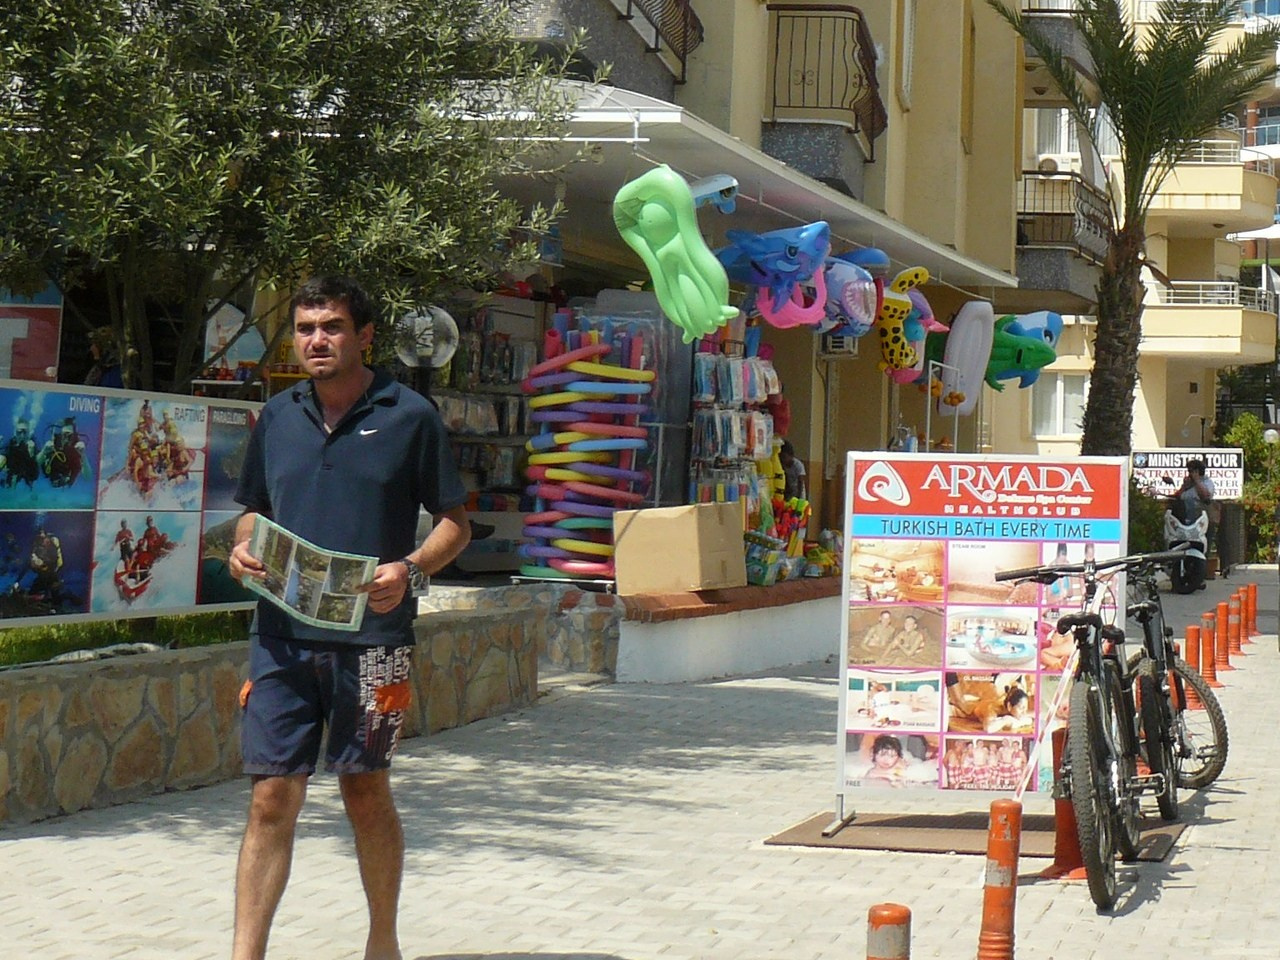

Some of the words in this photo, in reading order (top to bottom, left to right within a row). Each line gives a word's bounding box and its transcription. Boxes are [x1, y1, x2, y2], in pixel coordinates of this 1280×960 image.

[69, 396, 100, 413] DIVING
[174, 407, 205, 422] RAFTING
[1206, 453, 1238, 467] TOUR
[920, 464, 1095, 502] ARMADA
[1212, 488, 1239, 496] STATE
[881, 519, 948, 536] TURKISH
[954, 520, 995, 537] BATH
[1001, 522, 1048, 538] EVERY
[1054, 522, 1091, 539] TIME
